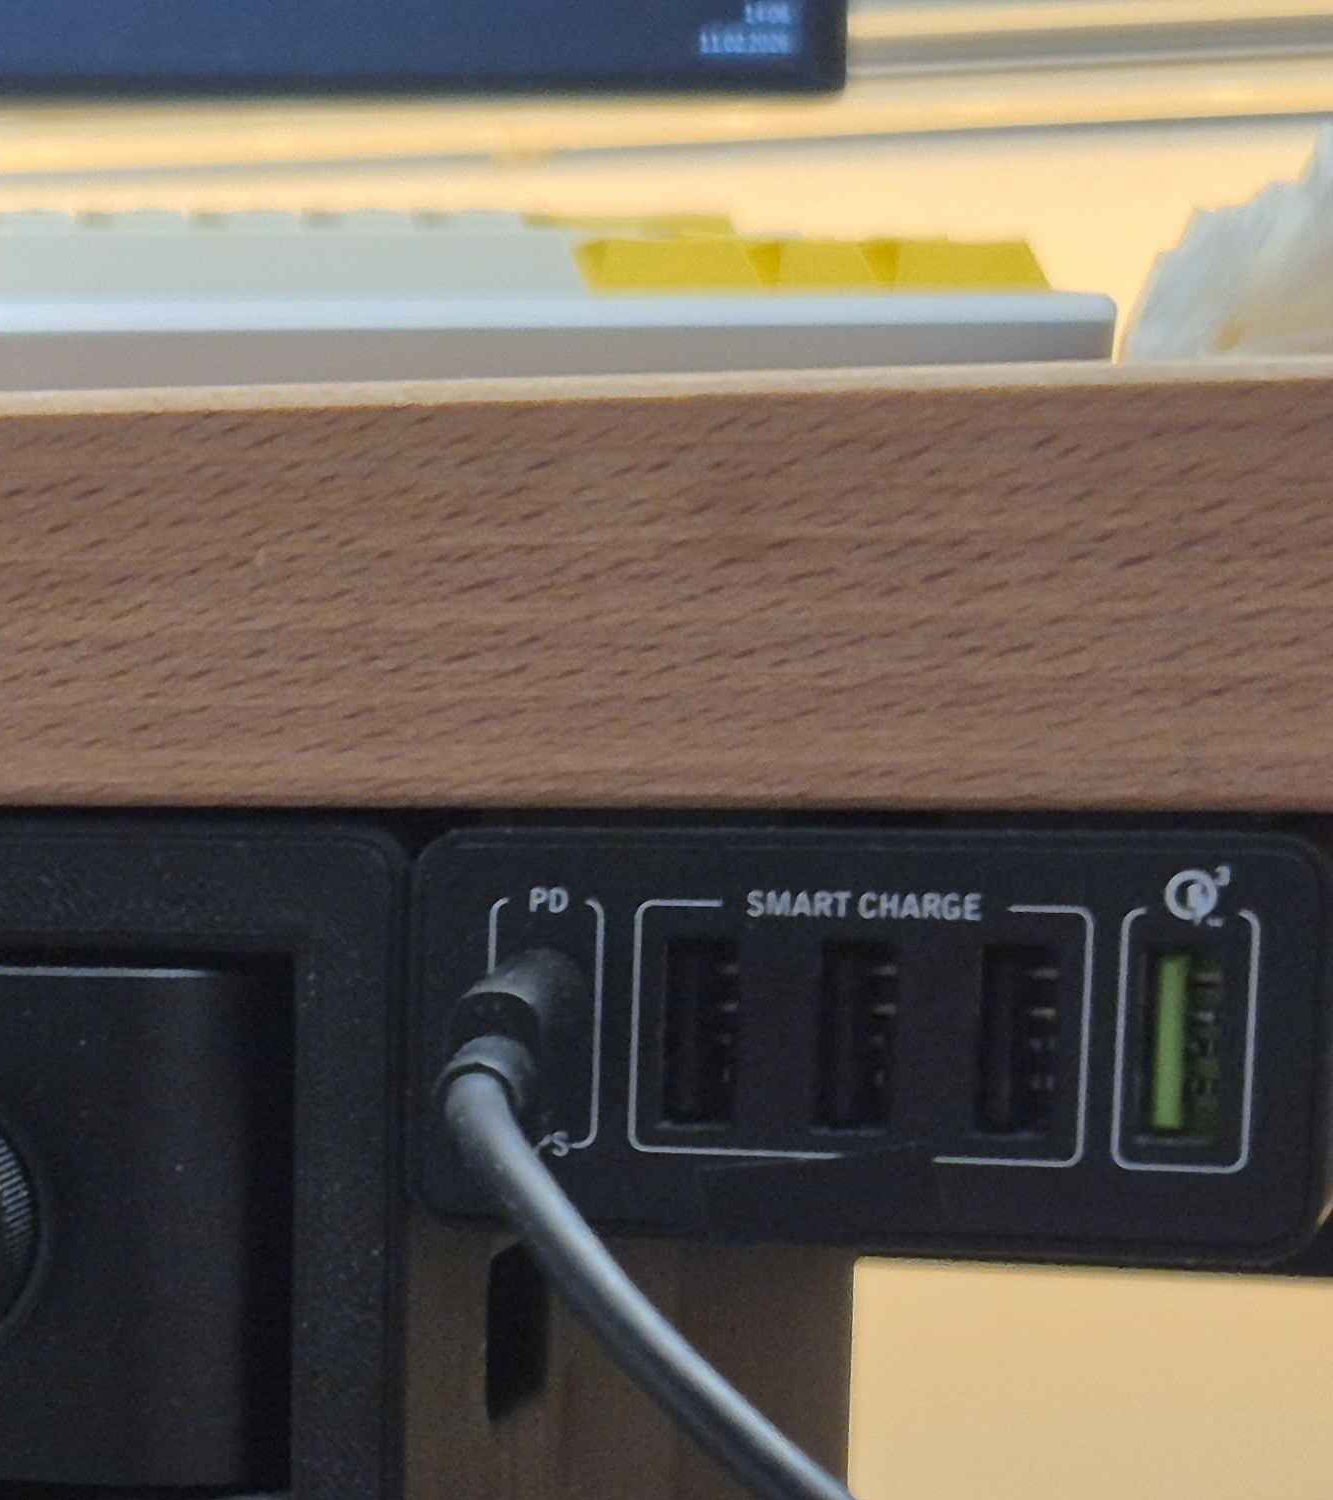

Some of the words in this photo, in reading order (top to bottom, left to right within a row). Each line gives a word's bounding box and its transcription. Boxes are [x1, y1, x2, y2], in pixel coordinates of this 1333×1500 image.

[528, 888, 570, 913] PD
[746, 890, 852, 919] SMART
[857, 893, 983, 922] CHARGE
